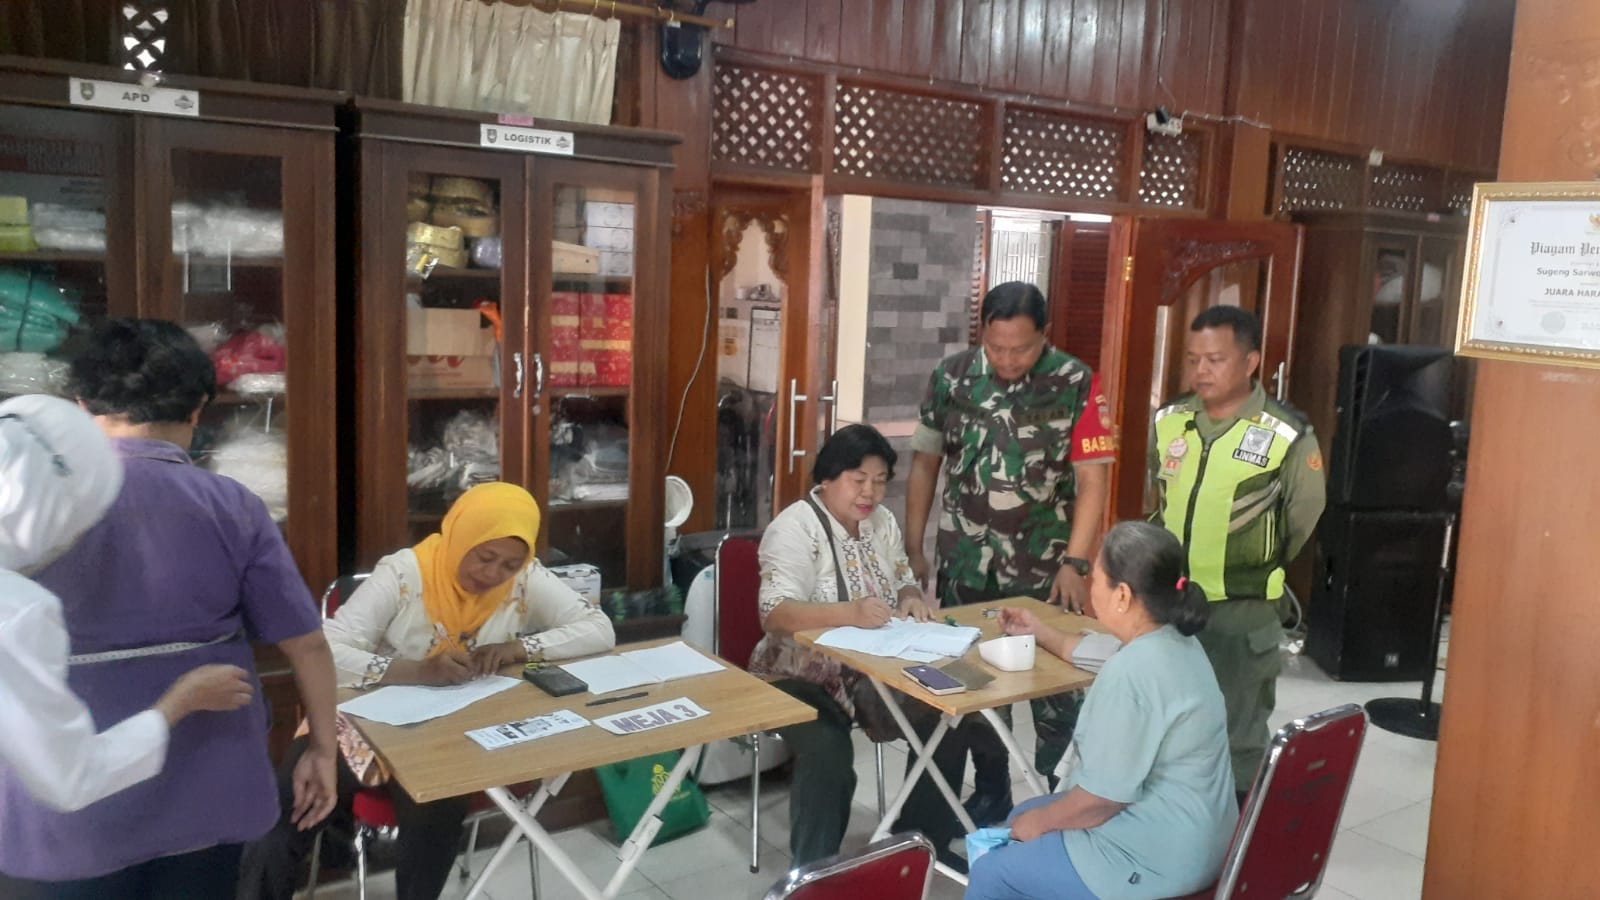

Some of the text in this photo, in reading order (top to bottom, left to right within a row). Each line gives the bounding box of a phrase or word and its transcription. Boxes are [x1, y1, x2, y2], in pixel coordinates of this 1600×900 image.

[122, 92, 150, 103] APD
[504, 133, 552, 145] LOGISTIK
[1536, 267, 1570, 278] Sugeng
[1544, 288, 1575, 297] JUARA
[1234, 449, 1268, 467] LINMAS
[610, 704, 698, 732] MEJA 3
